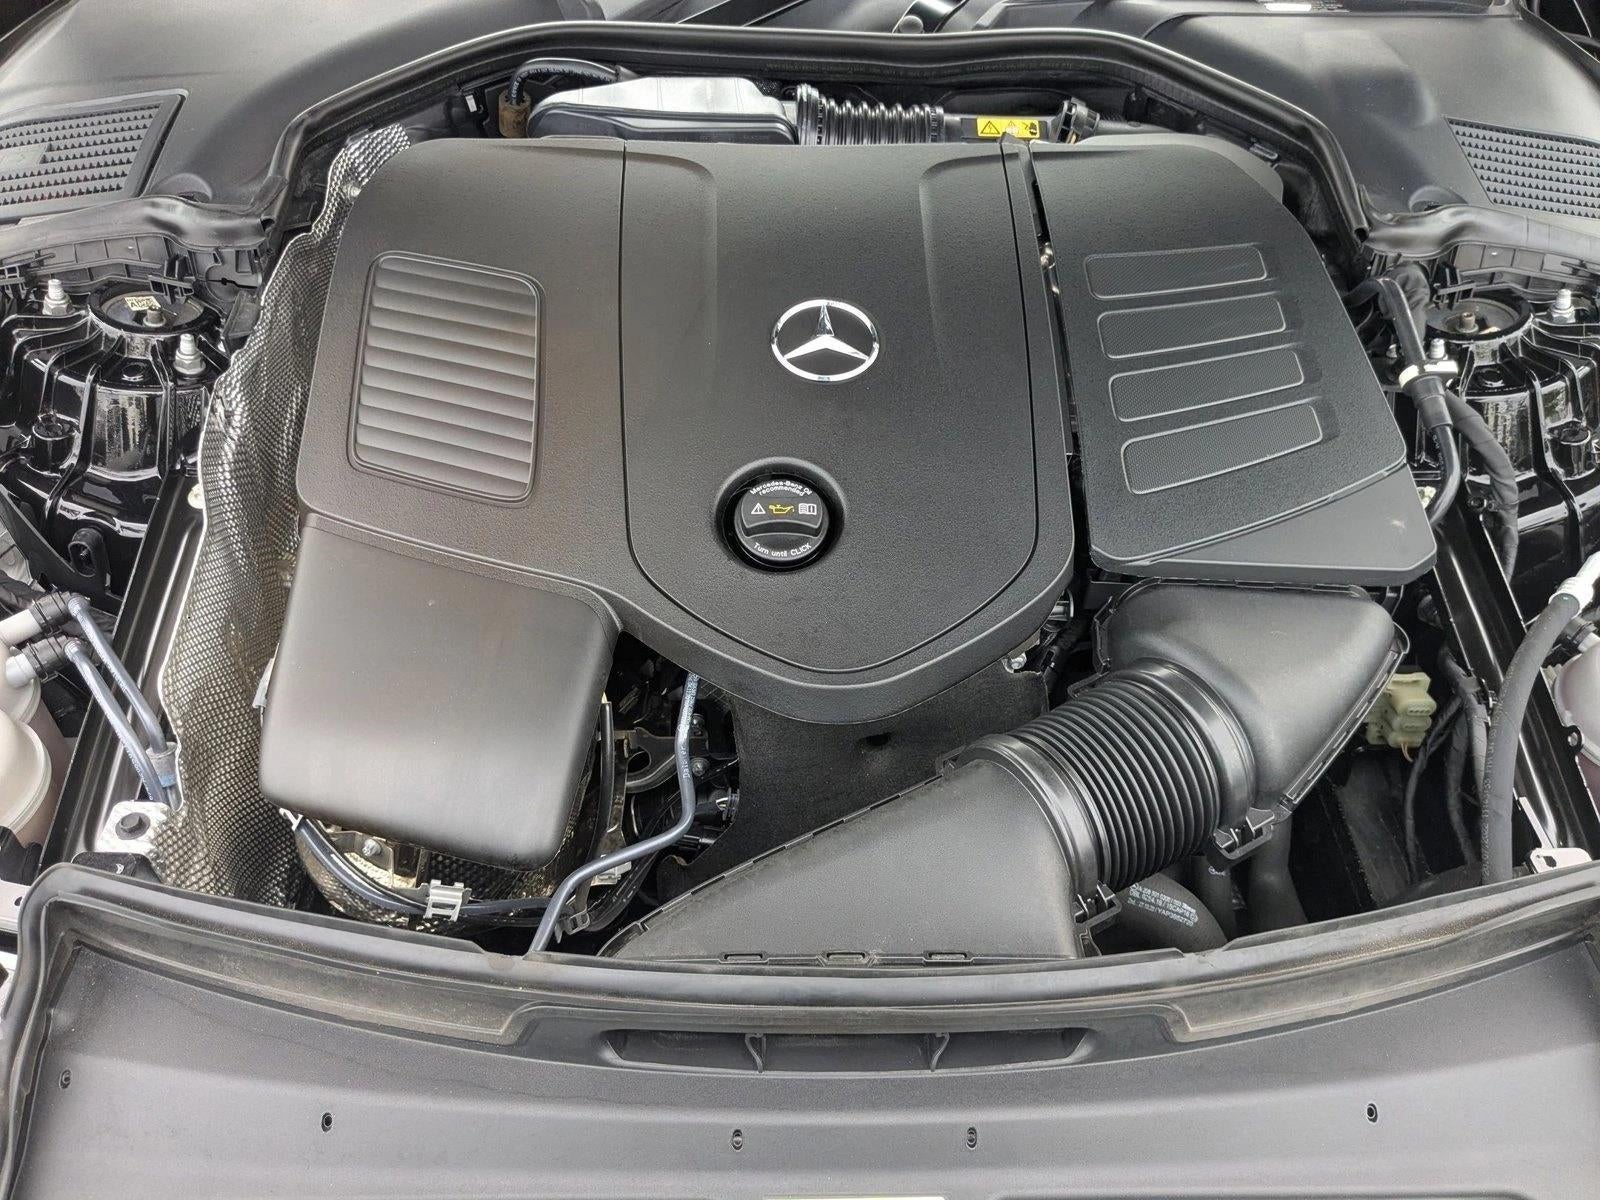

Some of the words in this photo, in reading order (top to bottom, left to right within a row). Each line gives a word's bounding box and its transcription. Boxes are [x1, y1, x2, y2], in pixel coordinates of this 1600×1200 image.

[750, 481, 803, 495] Mercedes-Benz
[759, 485, 805, 497] recommended
[754, 542, 769, 555] Turn
[790, 542, 812, 556] CLICK
